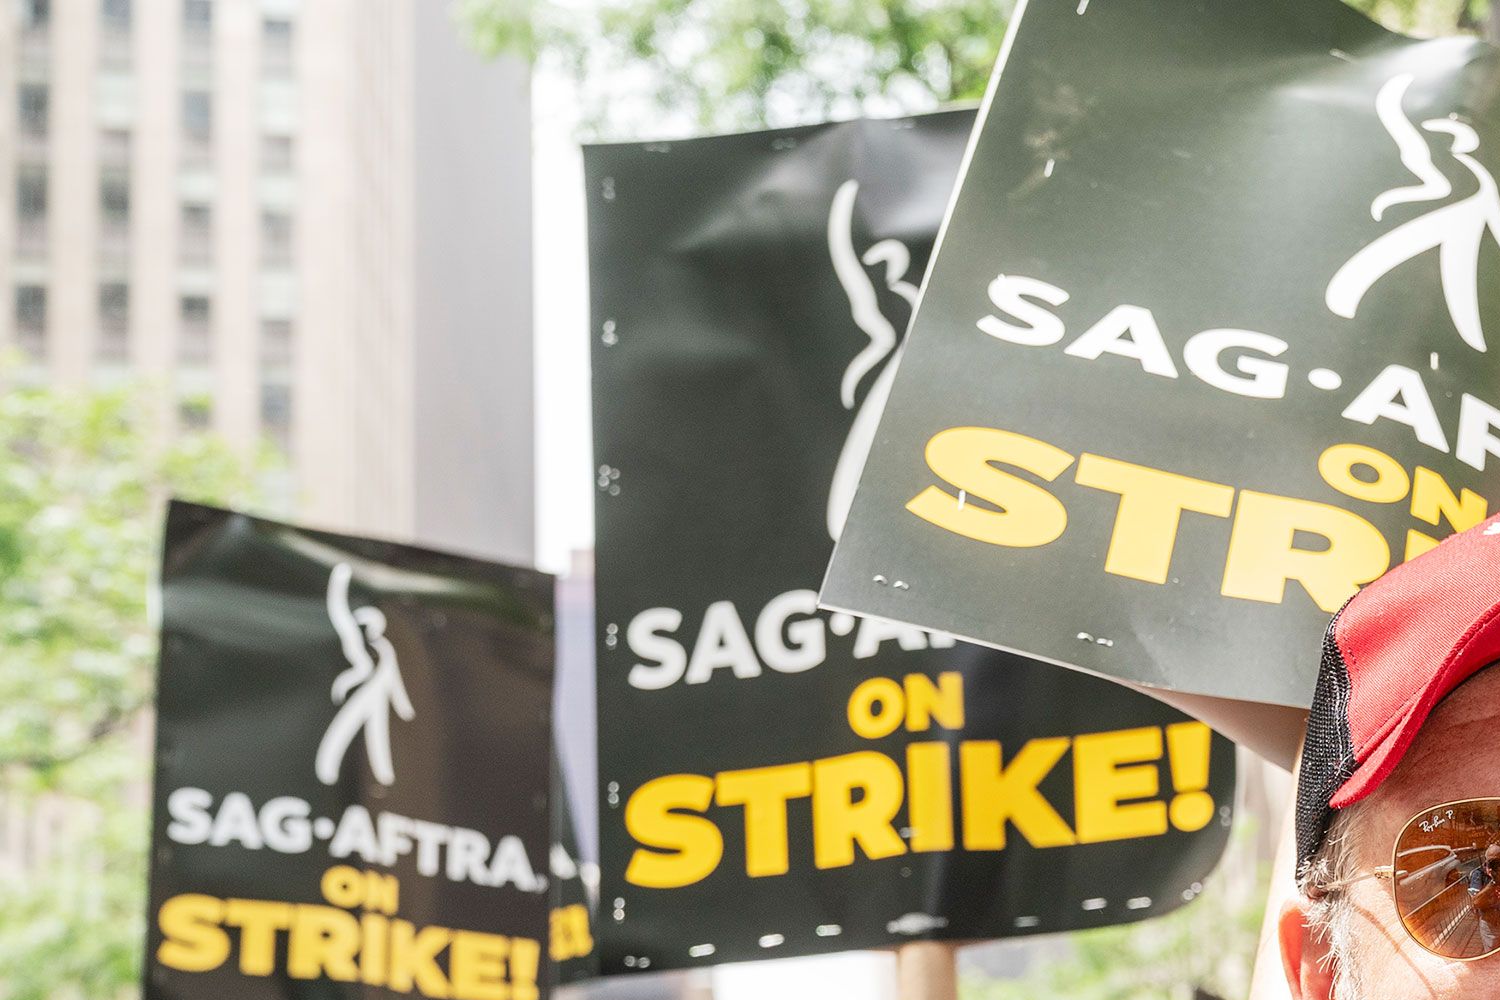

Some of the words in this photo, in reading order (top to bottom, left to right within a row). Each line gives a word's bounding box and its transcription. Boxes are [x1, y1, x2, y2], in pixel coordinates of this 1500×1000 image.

[1317, 443, 1488, 526] ON
[846, 671, 965, 739] ON
[624, 721, 1216, 889] STRIKE!
[319, 864, 400, 916] ON
